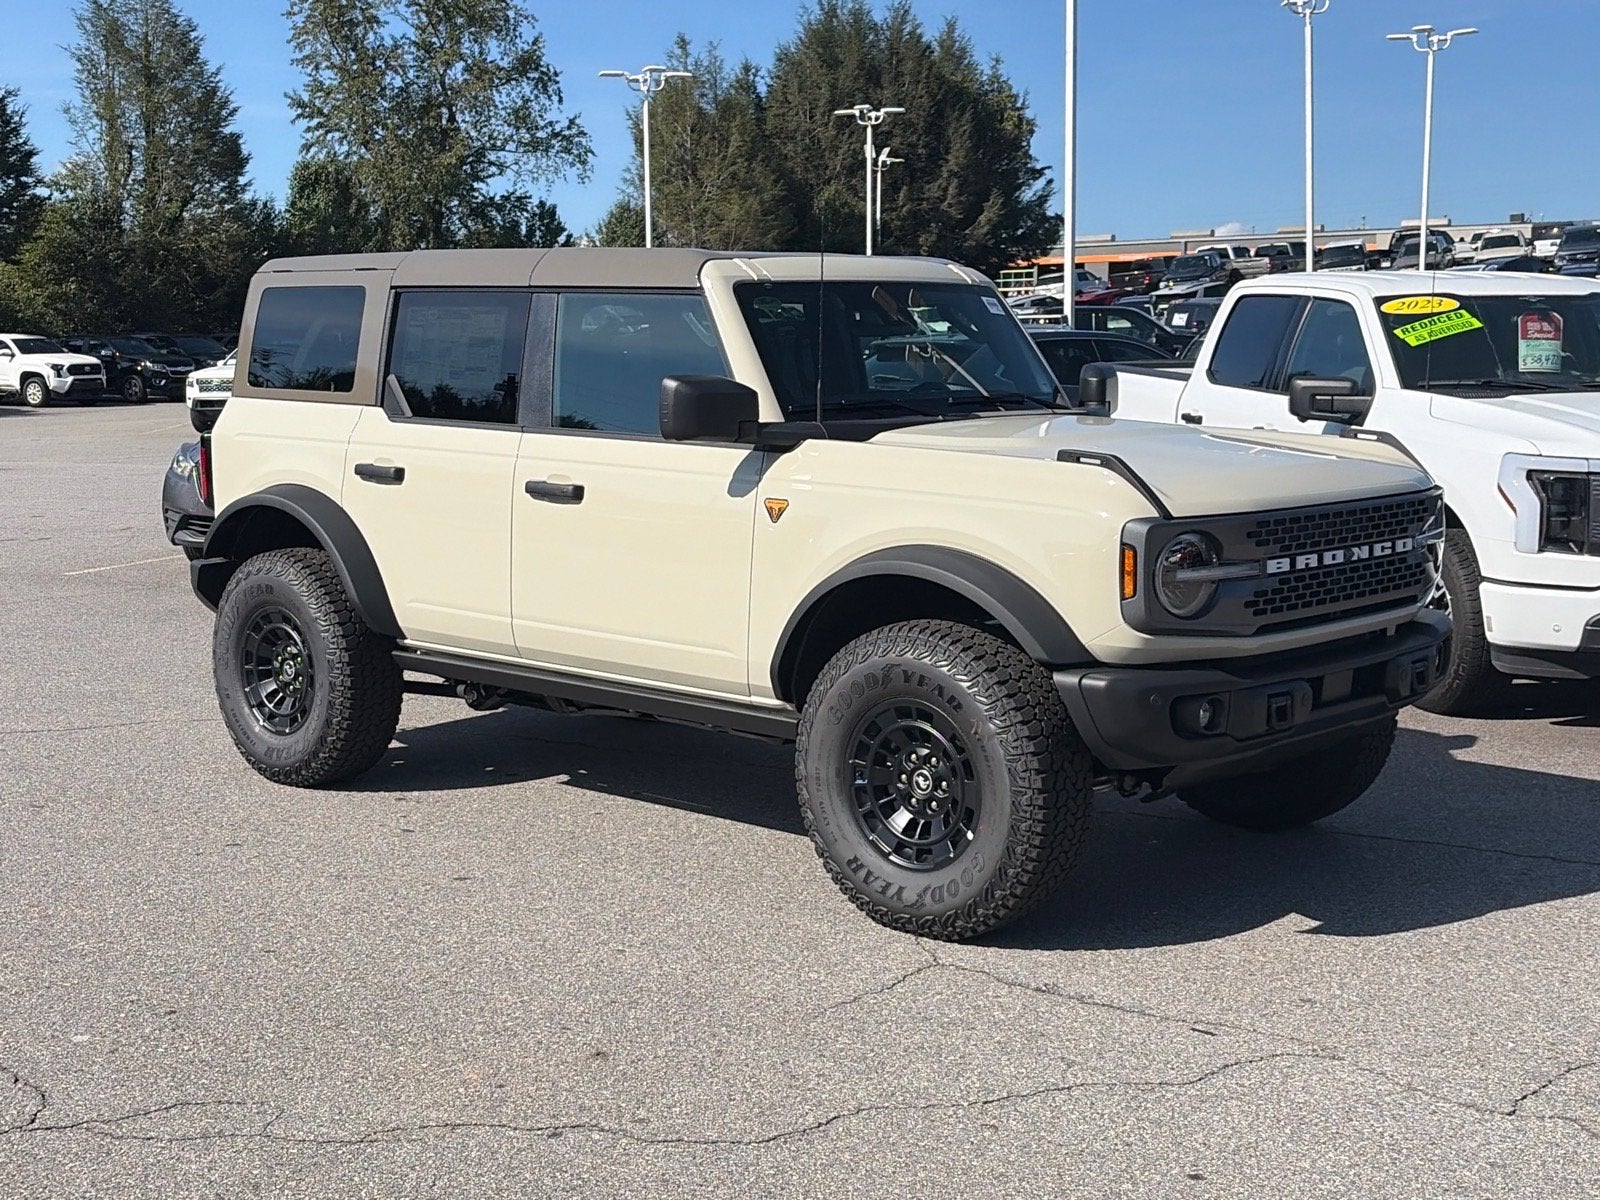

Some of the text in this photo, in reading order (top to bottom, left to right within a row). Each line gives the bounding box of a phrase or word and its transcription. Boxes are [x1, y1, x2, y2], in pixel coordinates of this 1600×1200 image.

[1394, 299, 1444, 311] 2023
[1400, 311, 1464, 335] REDUCED
[1415, 320, 1474, 342] AS ADVERTISED
[1266, 538, 1413, 574] BRONCO
